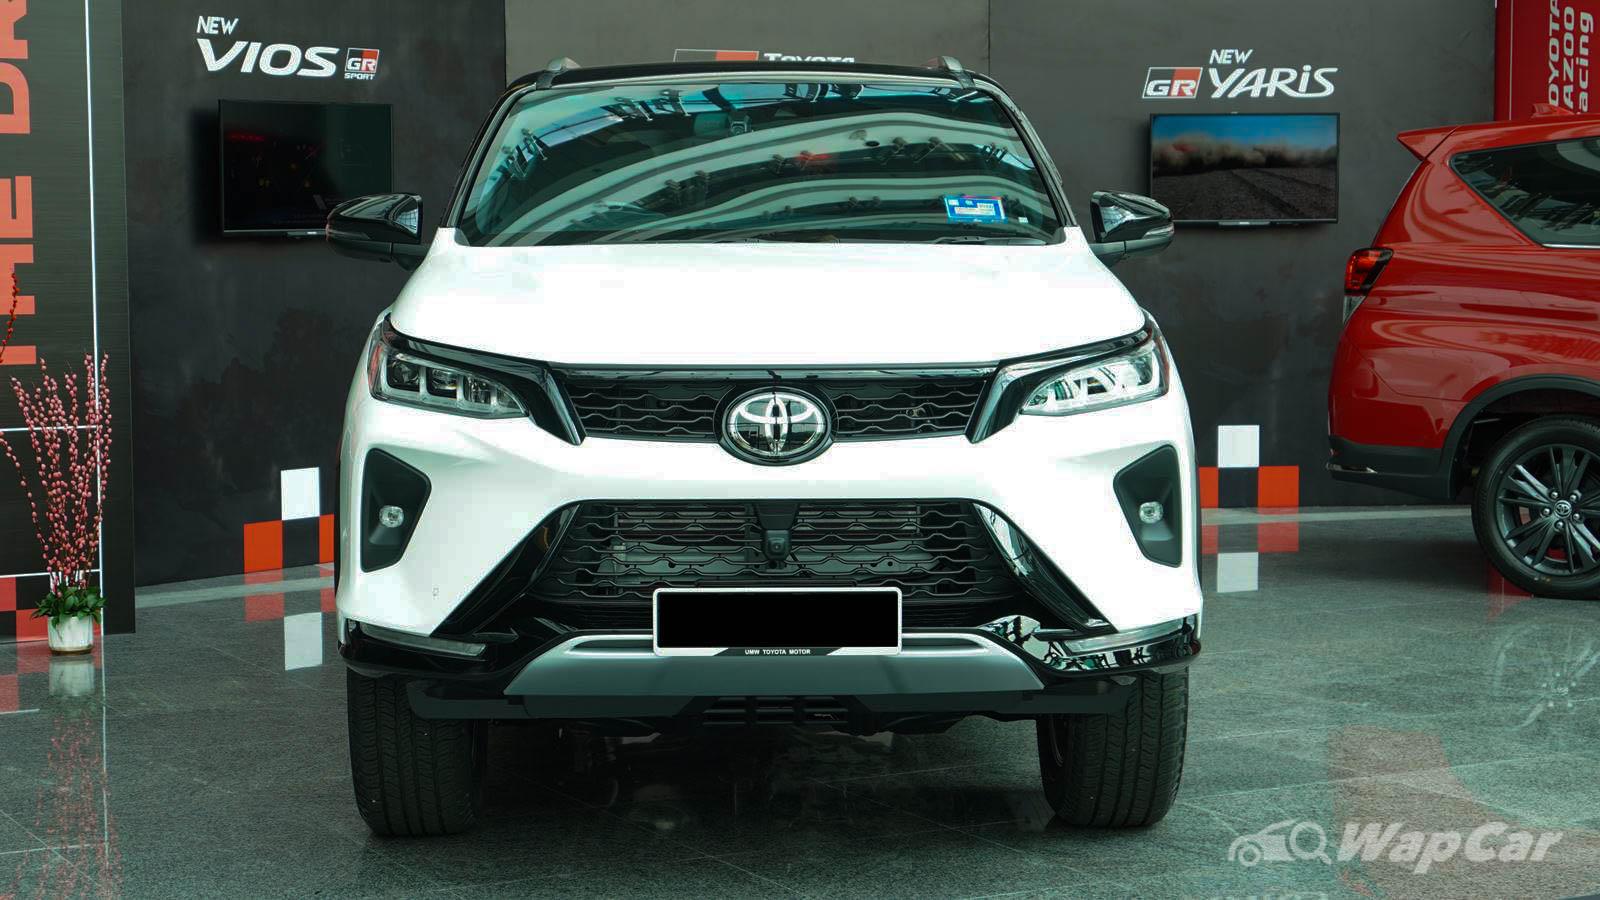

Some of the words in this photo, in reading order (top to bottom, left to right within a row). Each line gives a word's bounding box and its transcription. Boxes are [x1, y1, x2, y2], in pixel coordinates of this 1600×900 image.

[197, 16, 238, 34] NEW
[197, 38, 339, 77] VIOS
[347, 57, 377, 71] GR
[1210, 49, 1252, 64] NEW
[1549, 0, 1560, 107] OYOTA
[1563, 6, 1574, 109] AZOO
[1576, 12, 1594, 114] acing
[344, 72, 376, 80] SPORT
[1146, 79, 1197, 96] GR
